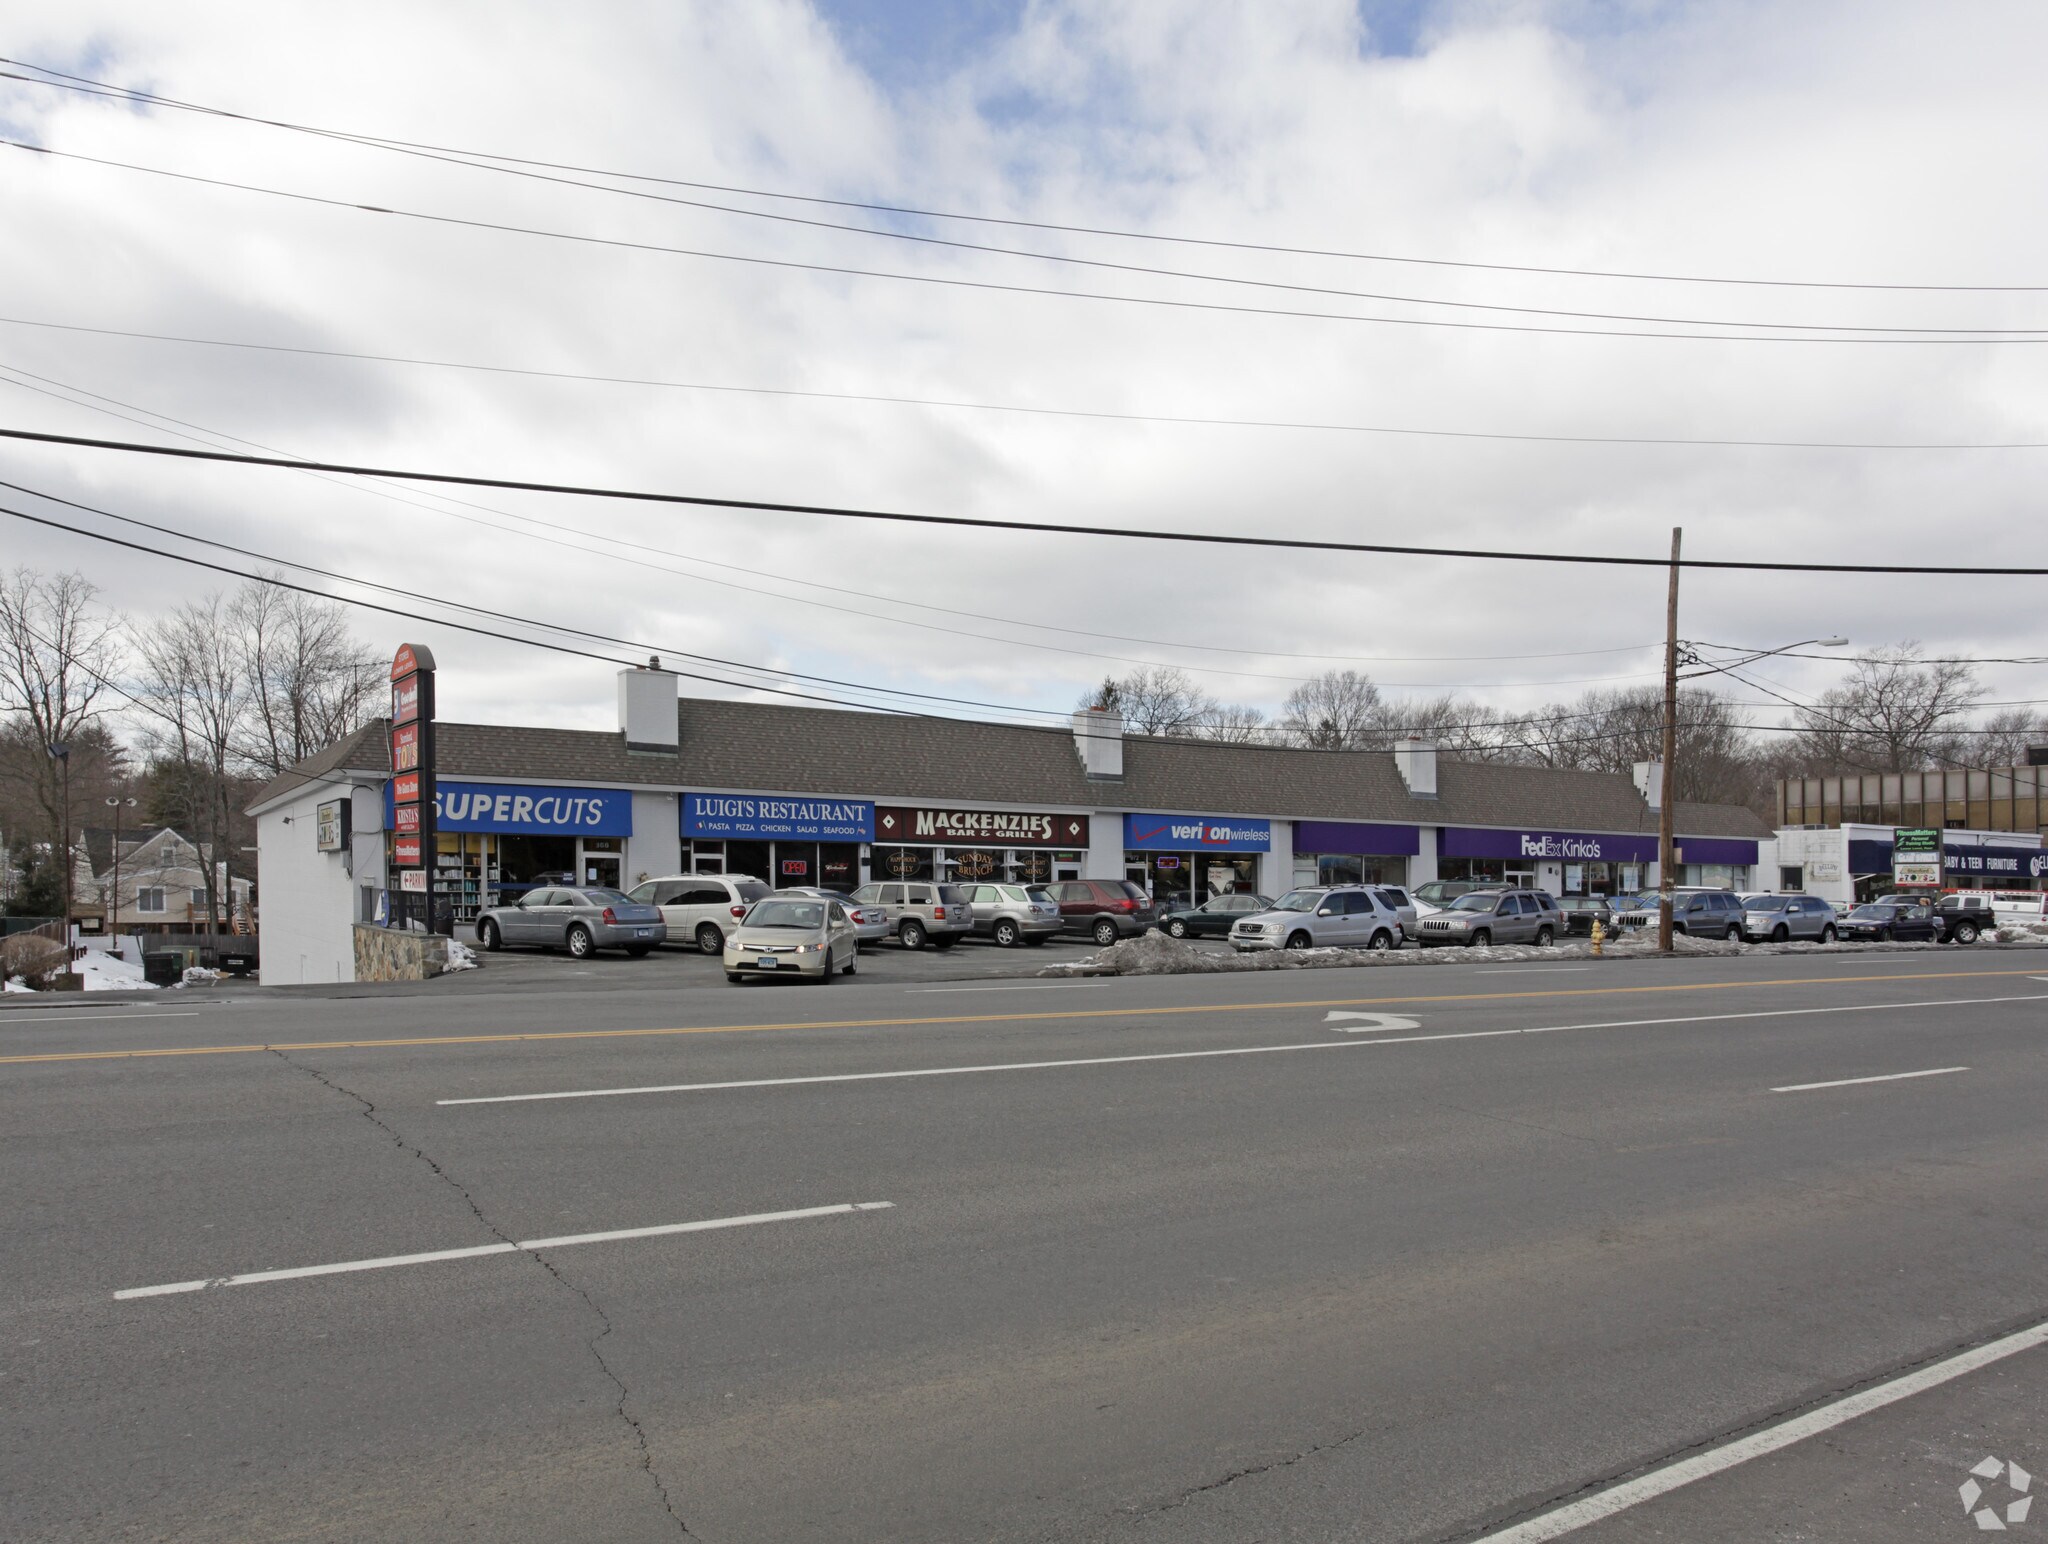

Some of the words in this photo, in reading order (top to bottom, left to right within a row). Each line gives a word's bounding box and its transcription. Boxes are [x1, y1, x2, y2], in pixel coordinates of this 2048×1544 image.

[395, 742, 418, 770] TOYS
[695, 798, 755, 819] LUIGI'S
[759, 801, 866, 822] RESTAURANT
[708, 822, 730, 831] PASTA
[735, 823, 755, 832] PIZZA
[760, 824, 792, 833] CHICKEN
[796, 826, 818, 834] SALAD
[823, 827, 855, 835] SEAFOOD
[915, 810, 1052, 840] MACKENZIES
[1171, 821, 1231, 845] verizon
[1230, 828, 1270, 841] wireless
[946, 828, 975, 837] BAR
[996, 831, 1036, 839] GRILL
[1521, 834, 1562, 857] FedEx
[1562, 838, 1601, 858] Kinko's
[957, 853, 993, 864] SUNDAY
[1960, 856, 1967, 869] &
[1967, 857, 1983, 869] TEEN
[1986, 858, 2018, 871] FURNITURE
[784, 861, 805, 874] OPEN
[958, 864, 993, 876] BRUNCH
[408, 872, 426, 889] PARKIN
